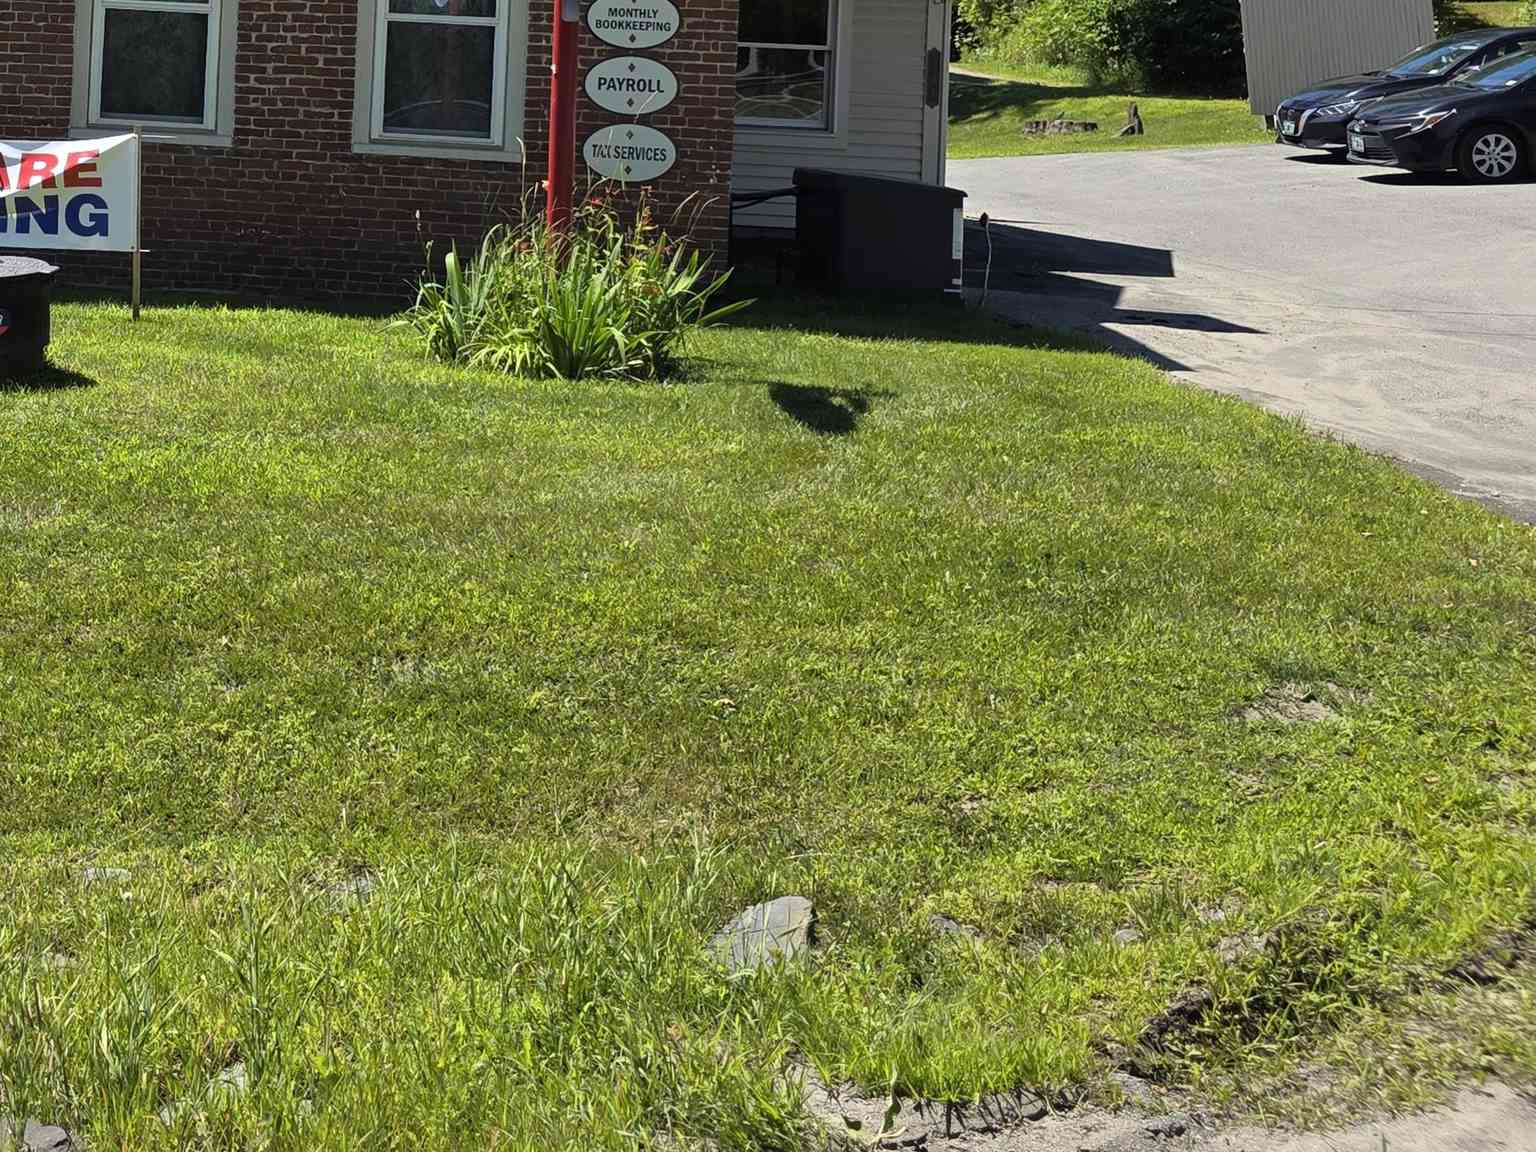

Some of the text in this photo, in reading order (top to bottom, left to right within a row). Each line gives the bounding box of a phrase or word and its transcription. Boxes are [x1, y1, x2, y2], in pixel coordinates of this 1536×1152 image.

[607, 7, 660, 19] MONTHLY
[595, 19, 672, 32] BOOKKEEPING
[597, 77, 665, 93] PAYROLL
[613, 144, 667, 162] SERVICES
